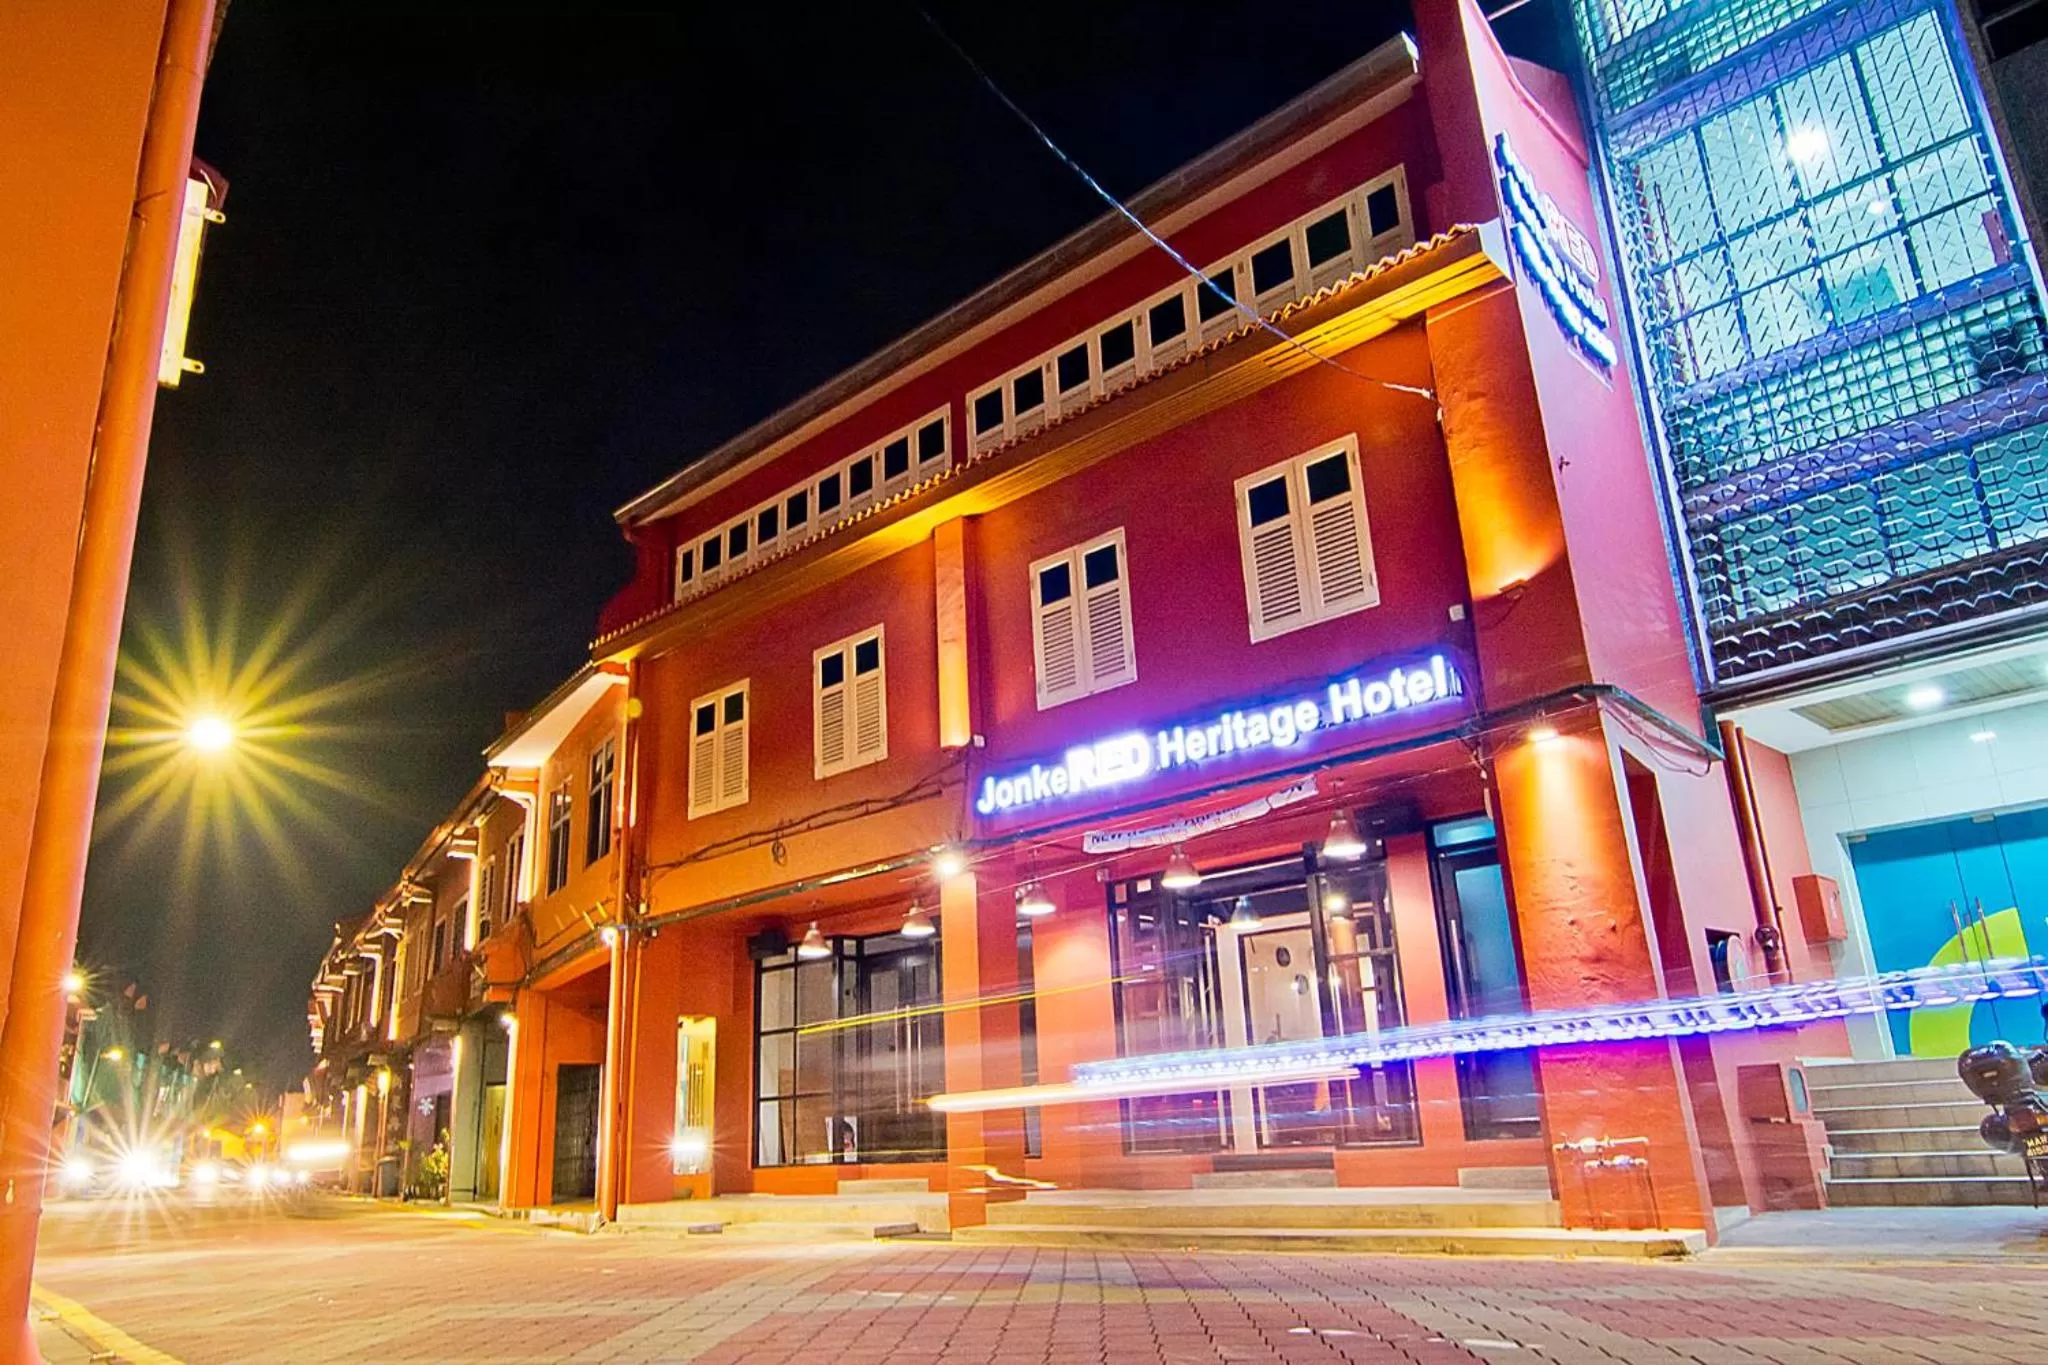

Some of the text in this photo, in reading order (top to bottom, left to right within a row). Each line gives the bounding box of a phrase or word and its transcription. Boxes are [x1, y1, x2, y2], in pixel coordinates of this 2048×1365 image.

[976, 654, 1447, 815] JonkeRED Heritage Hotel
